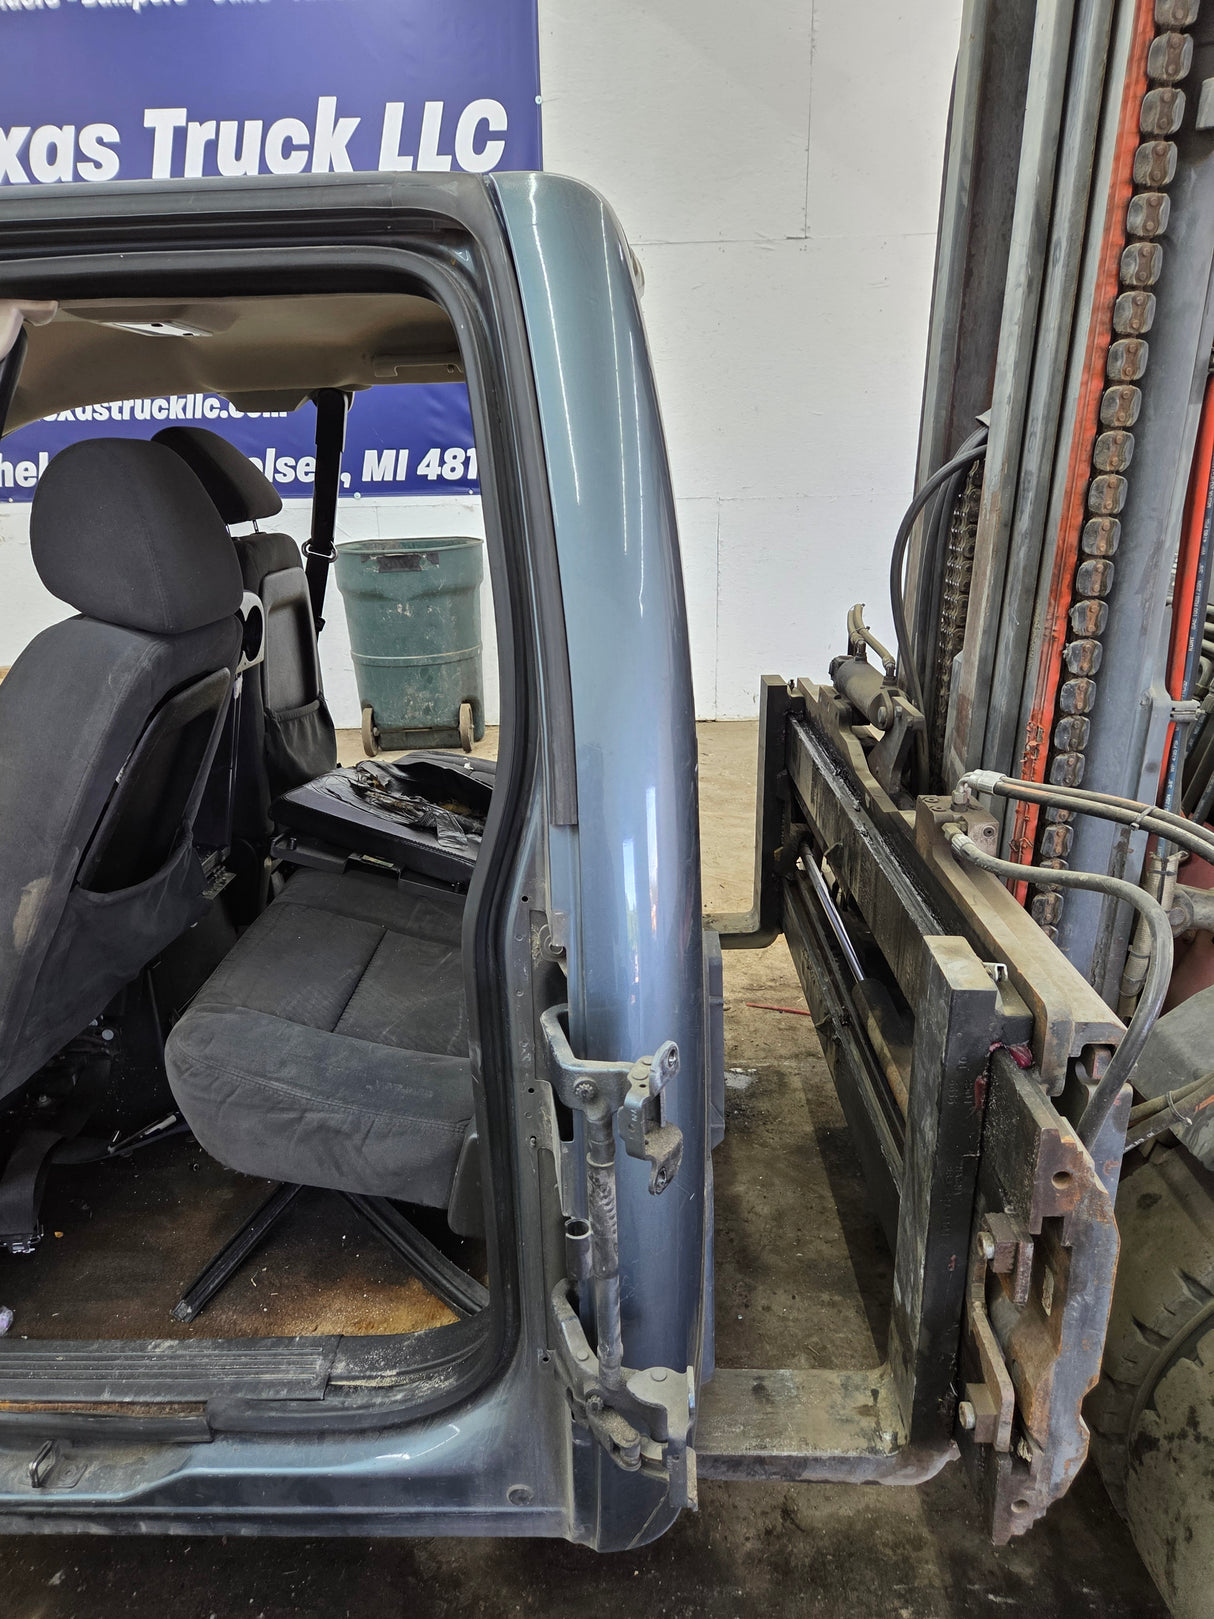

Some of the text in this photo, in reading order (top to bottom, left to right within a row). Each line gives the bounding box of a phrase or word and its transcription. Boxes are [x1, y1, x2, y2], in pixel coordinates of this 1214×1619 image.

[143, 96, 361, 179] Truck
[378, 99, 508, 173] LLC
[42, 393, 287, 420] xastruckllc.
[362, 449, 409, 482] MI
[416, 447, 478, 481] 481
